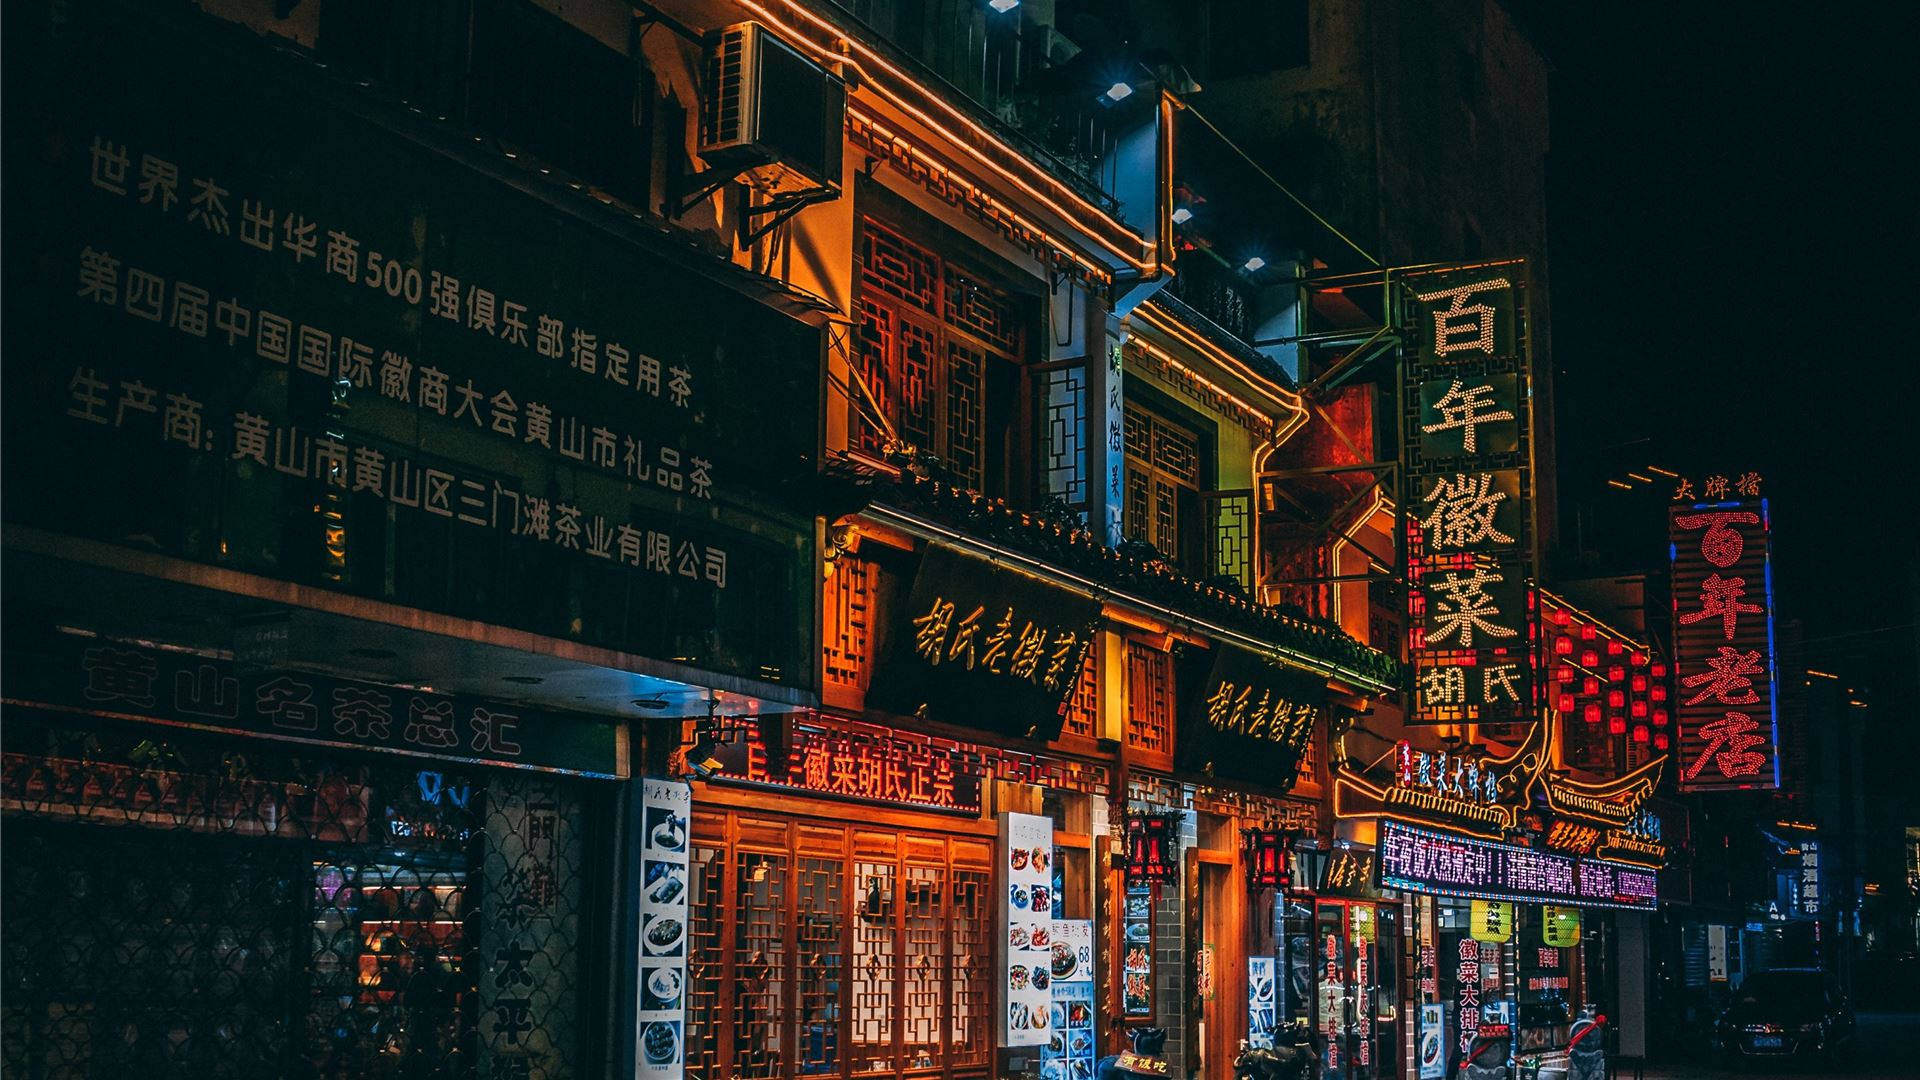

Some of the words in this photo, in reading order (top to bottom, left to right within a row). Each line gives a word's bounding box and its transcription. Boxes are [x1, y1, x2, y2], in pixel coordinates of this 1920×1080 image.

[90, 137, 693, 409] 世界杰出华商500强俱乐部指定用茶
[79, 246, 713, 499] 第四届中国国际徽商大会黄山市礼品茶
[1418, 278, 1515, 646] 百年徽菜
[81, 647, 521, 755] 黄山名茶总汇
[1422, 667, 1520, 703] 胡氏
[1674, 511, 1767, 780] 百年老店
[747, 738, 955, 806] 徽菜胡氏正宗
[1079, 946, 1090, 963] 68
